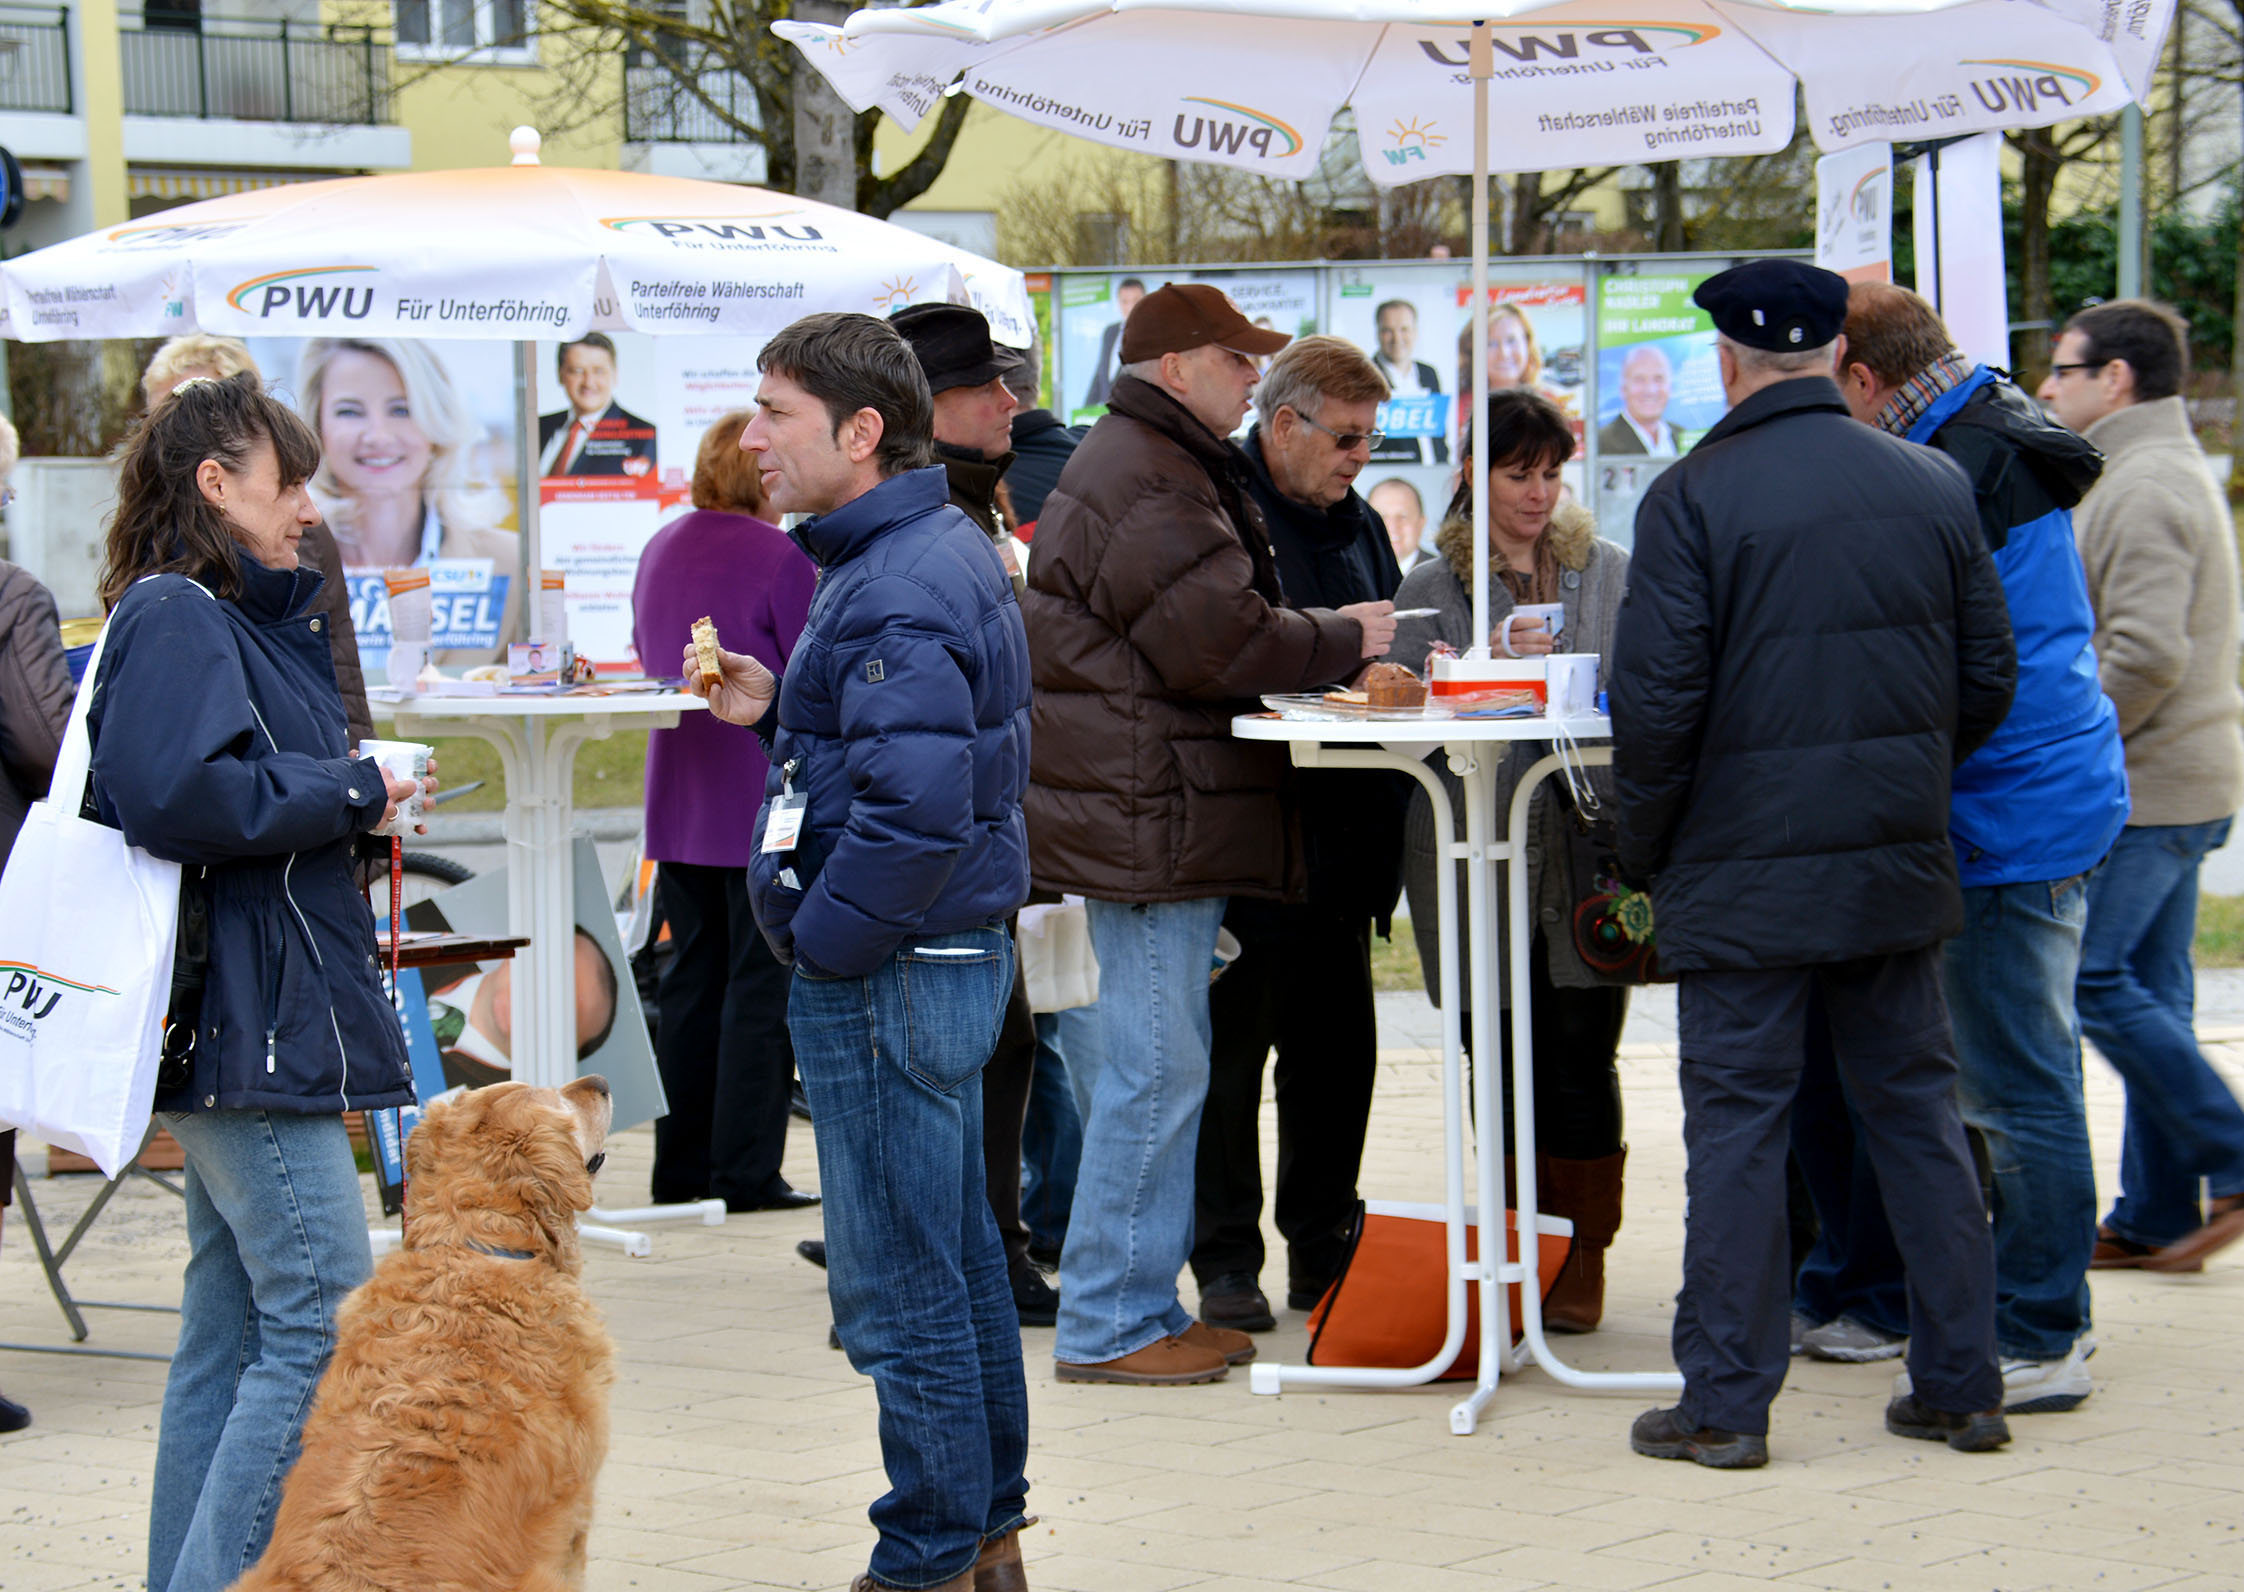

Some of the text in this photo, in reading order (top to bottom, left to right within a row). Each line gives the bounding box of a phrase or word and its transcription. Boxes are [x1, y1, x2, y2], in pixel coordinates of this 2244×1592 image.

[650, 222, 824, 241] PWU
[631, 280, 805, 300] Parteifreie Wählerschaft
[260, 286, 374, 320] PWU
[396, 298, 433, 321] Für
[439, 298, 572, 328] Unterföhring.
[634, 301, 721, 323] Unterföhring
